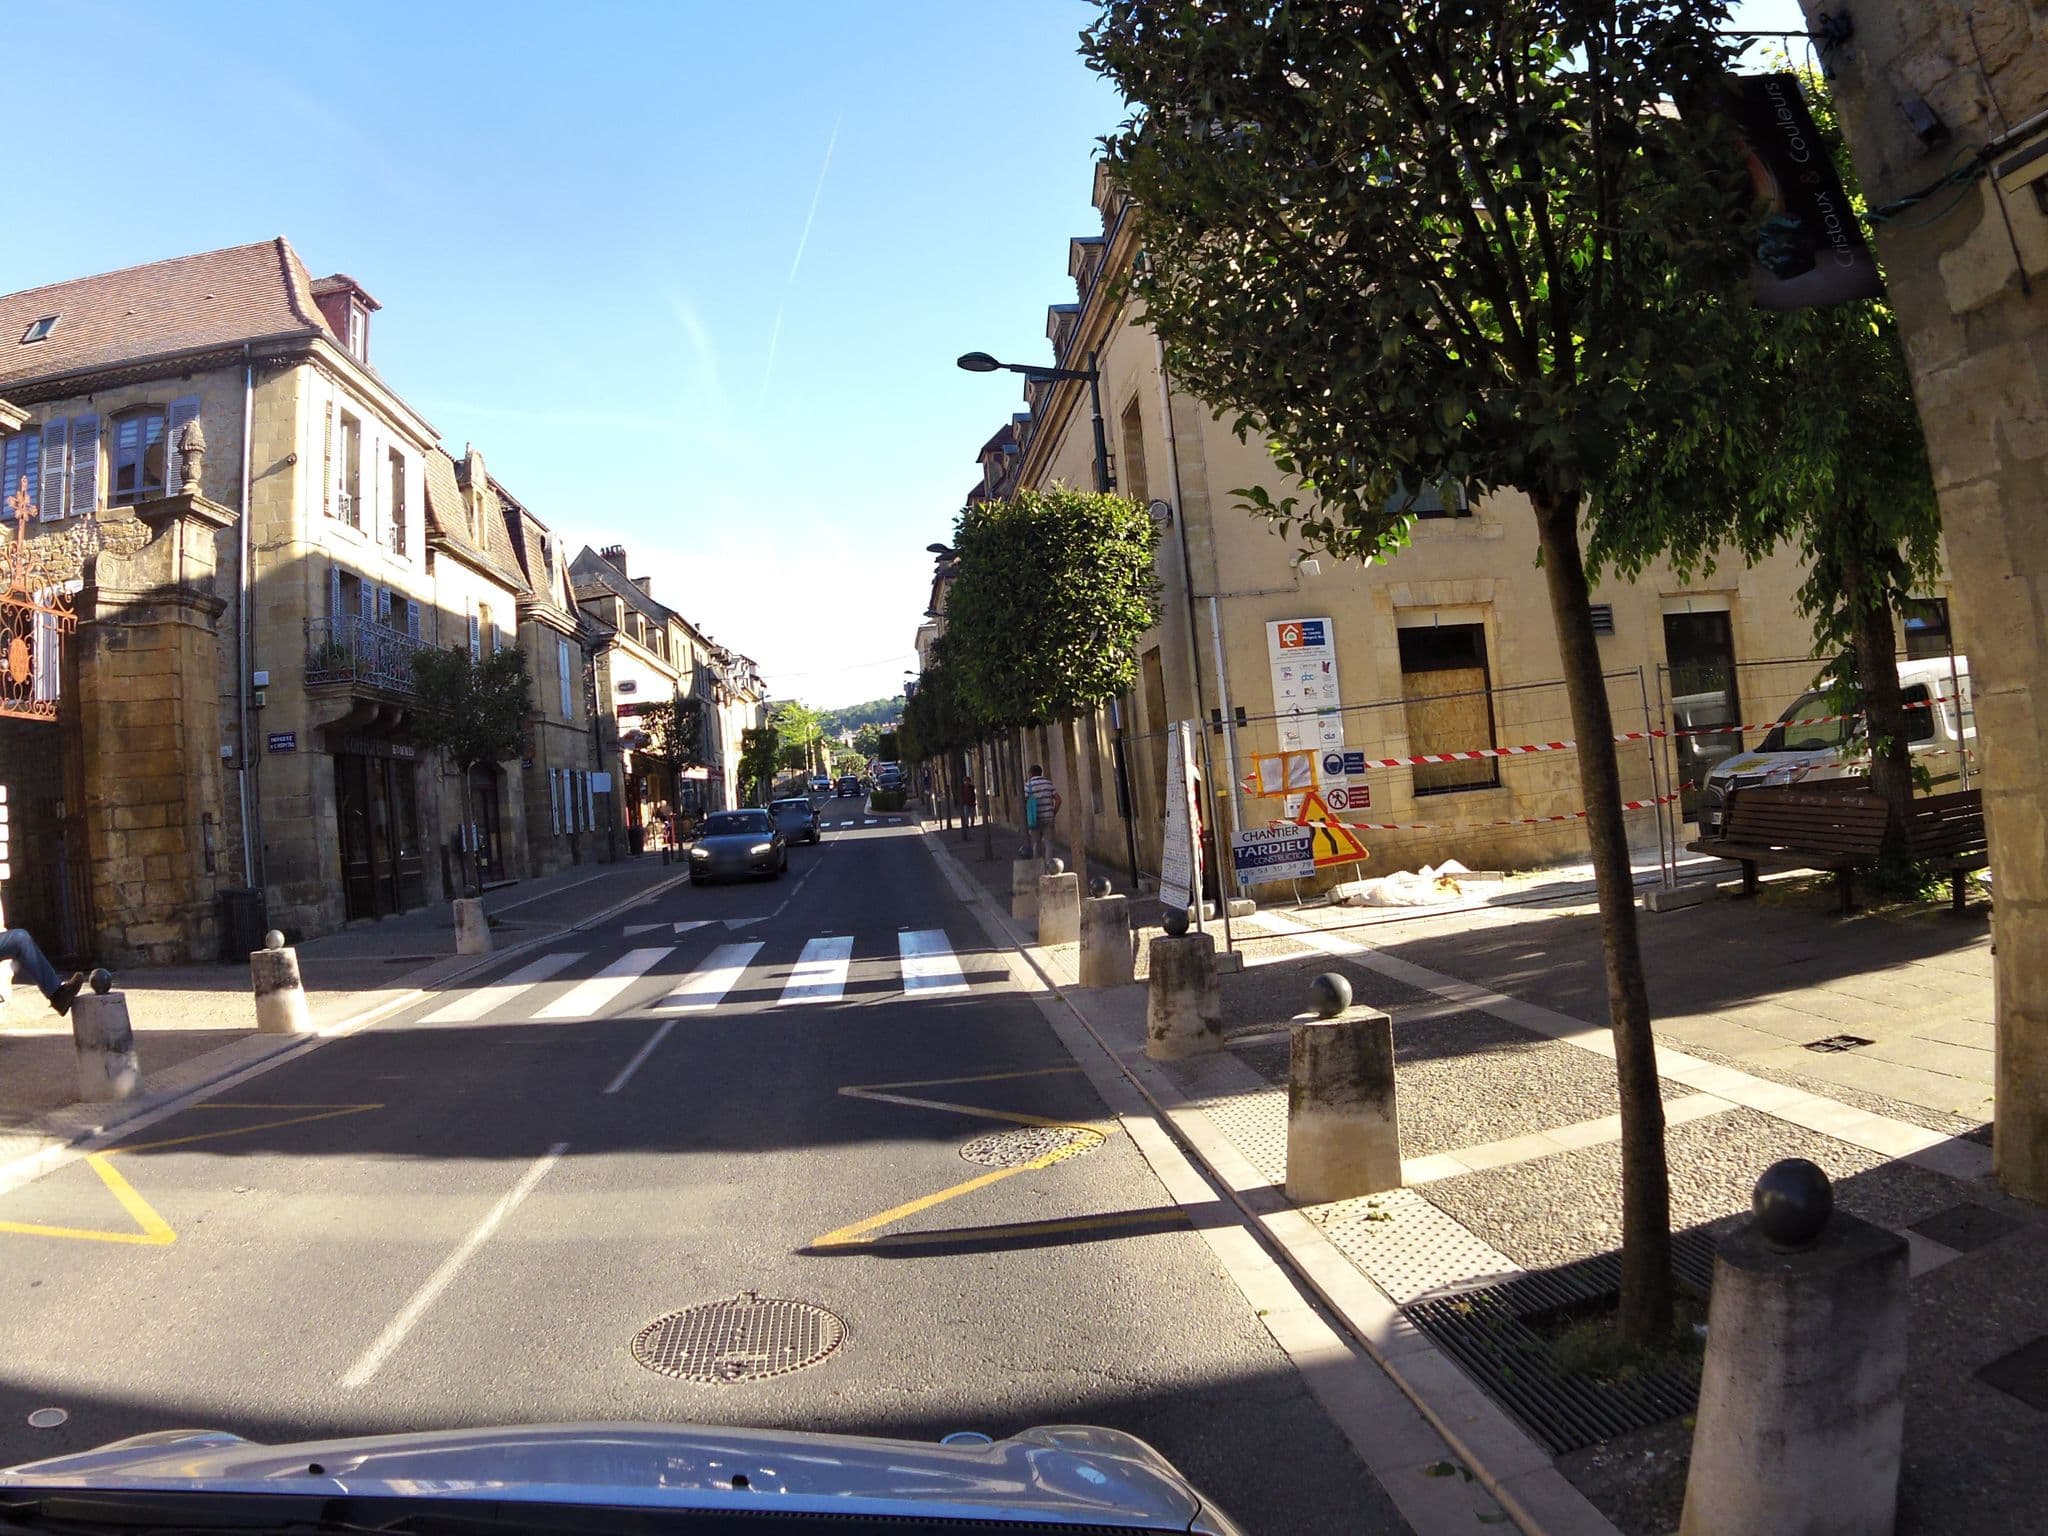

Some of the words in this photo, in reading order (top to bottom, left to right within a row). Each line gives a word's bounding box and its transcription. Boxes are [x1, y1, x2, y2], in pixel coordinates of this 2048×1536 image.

[1766, 82, 1810, 163] Couleurs
[1242, 826, 1299, 842] CHANTIER
[1234, 839, 1309, 858] TARDIEU
[1253, 851, 1310, 865] CONSTRUCTION
